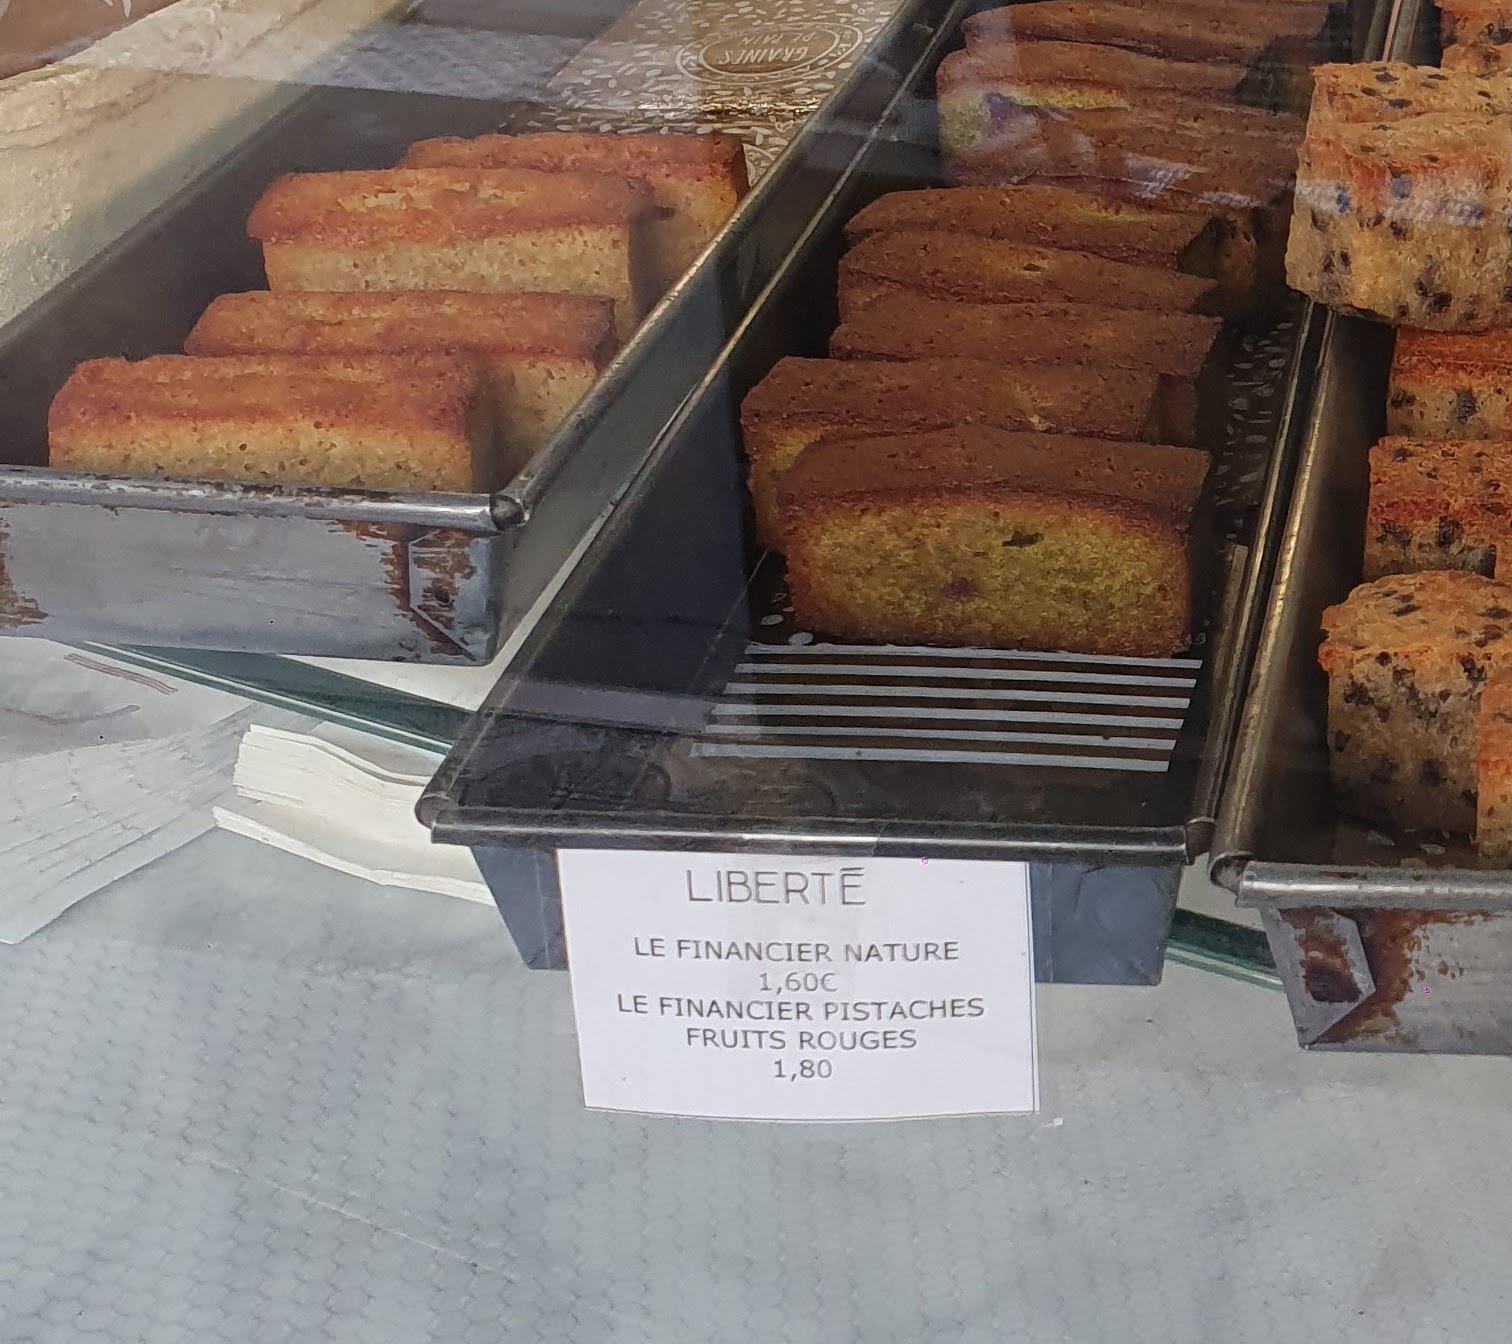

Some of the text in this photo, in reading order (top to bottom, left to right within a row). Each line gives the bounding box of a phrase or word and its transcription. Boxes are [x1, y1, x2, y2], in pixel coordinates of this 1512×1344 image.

[685, 866, 867, 906] LIBERTÉ
[634, 937, 960, 963] LE FINANCIER NATURE
[617, 993, 985, 1021] LE FINANCIER PISTACHES
[686, 1028, 918, 1051] FRUITS ROUGES
[773, 1059, 833, 1083] 1,80
